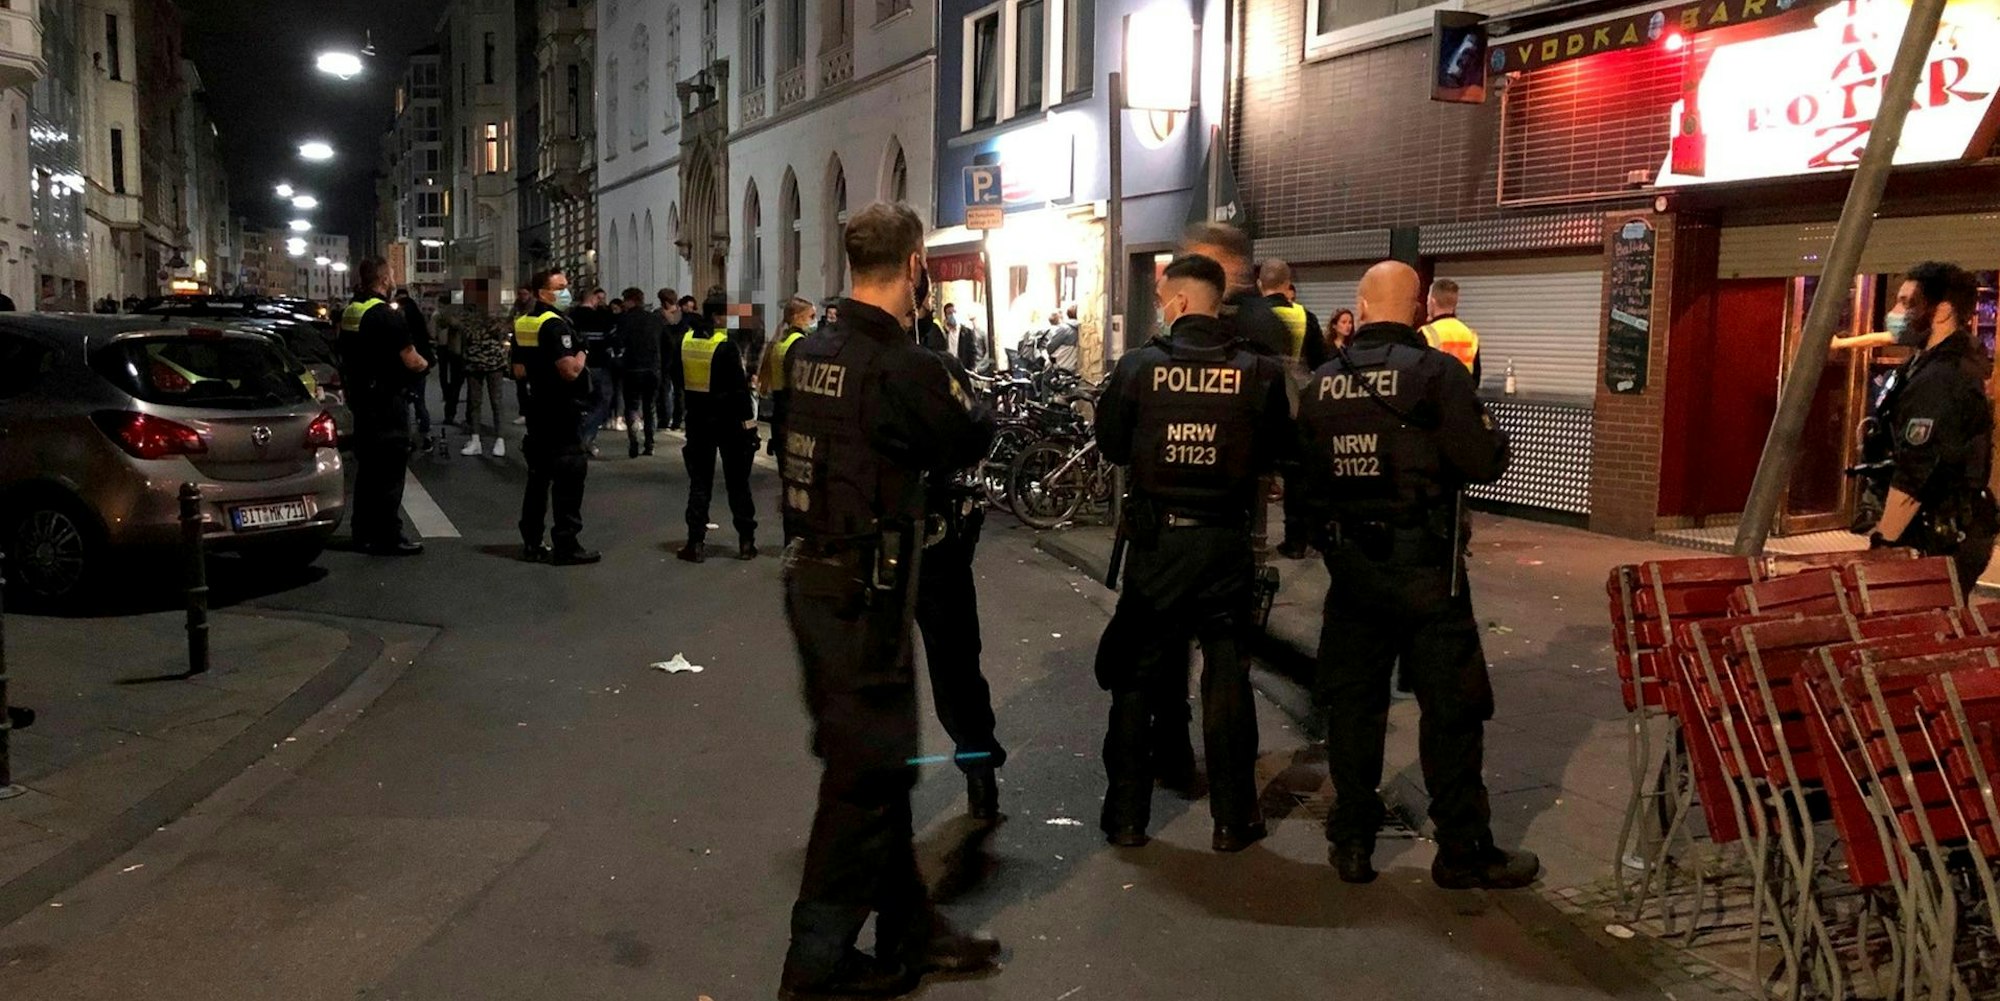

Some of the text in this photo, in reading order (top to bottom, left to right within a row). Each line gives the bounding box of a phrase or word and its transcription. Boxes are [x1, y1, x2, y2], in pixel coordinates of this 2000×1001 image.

[1518, 0, 1766, 65] VODKA BAR
[1747, 56, 1991, 132] ROTR
[973, 171, 993, 202] P
[1153, 366, 1242, 394] POLIZEI
[1167, 423, 1218, 442] NRW
[1333, 433, 1379, 454] NRW
[1165, 444, 1217, 465] 31123
[1333, 457, 1381, 477] 31122
[241, 506, 262, 525] BIT
